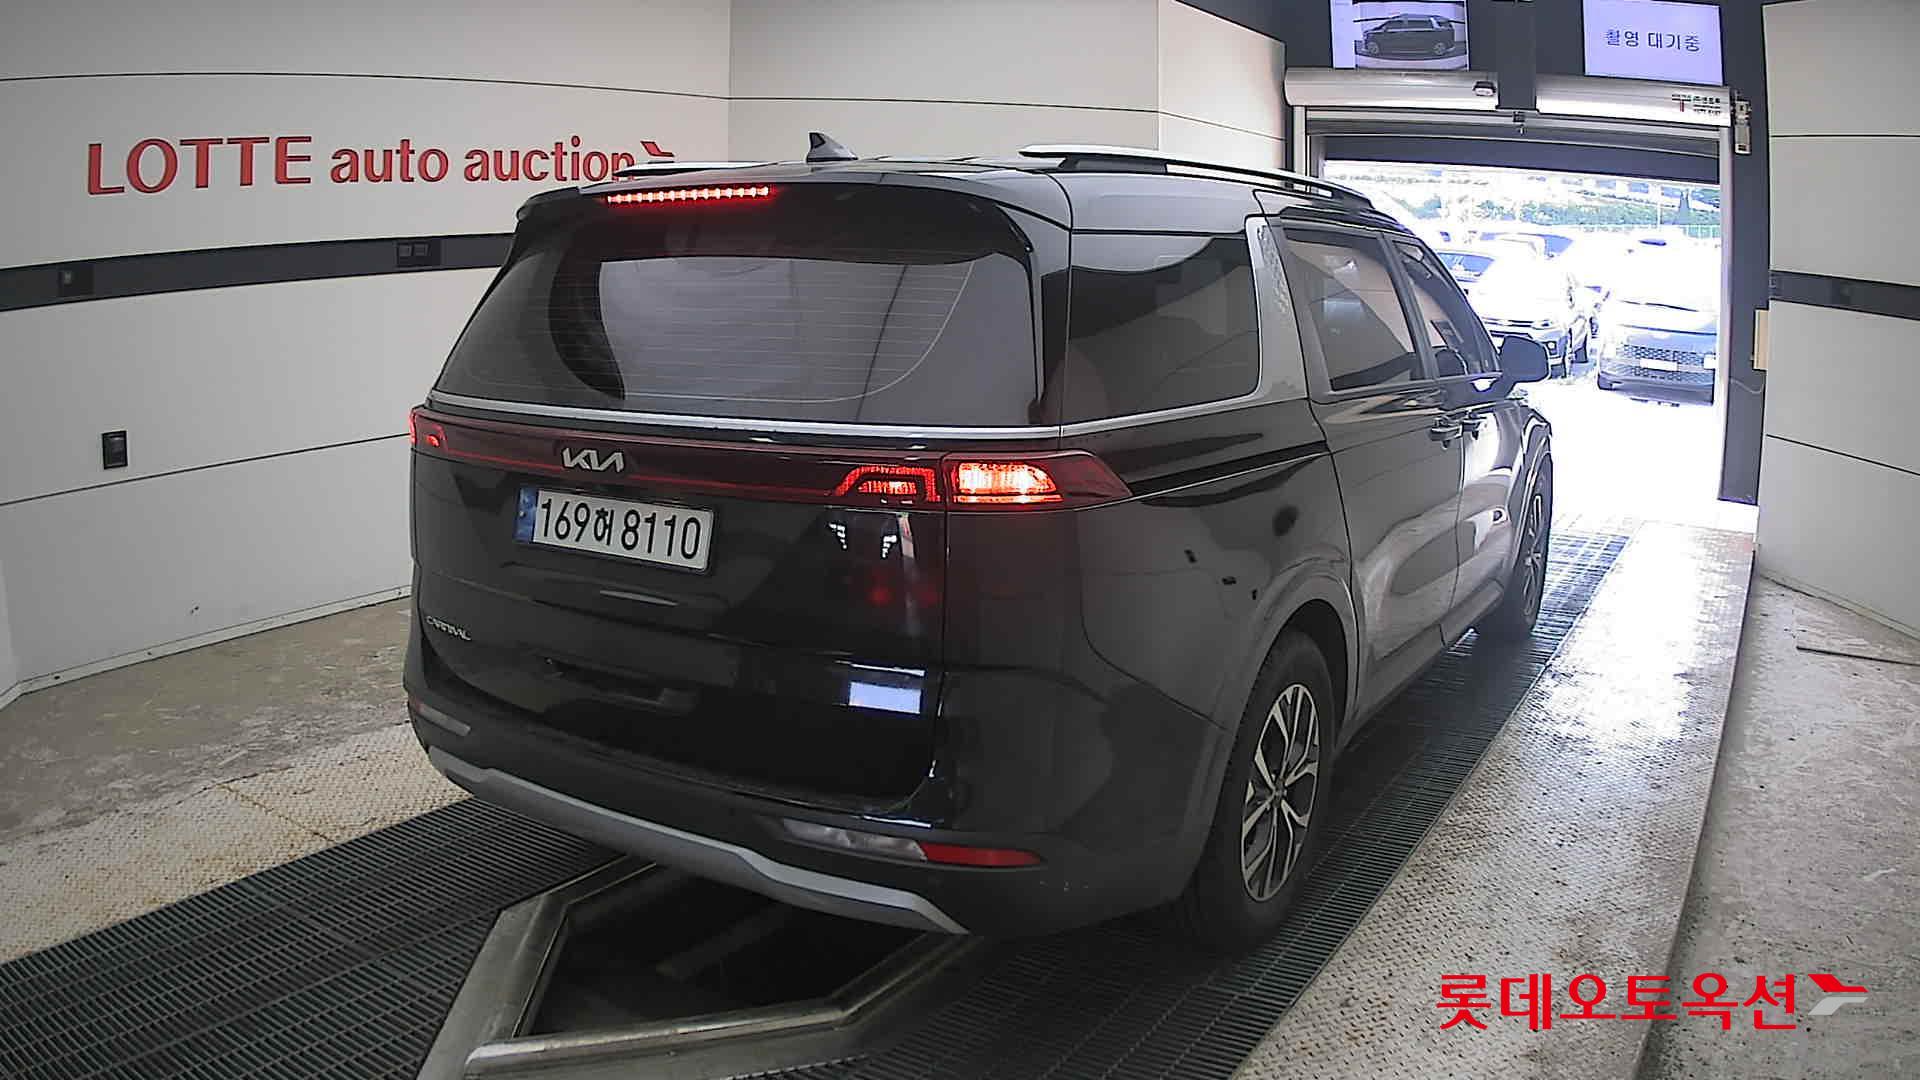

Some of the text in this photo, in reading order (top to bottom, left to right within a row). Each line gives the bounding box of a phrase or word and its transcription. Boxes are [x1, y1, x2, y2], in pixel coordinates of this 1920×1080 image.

[1647, 32, 1700, 52] 대기중
[88, 135, 637, 195] LOTTE auto auction
[561, 447, 625, 473] KIA
